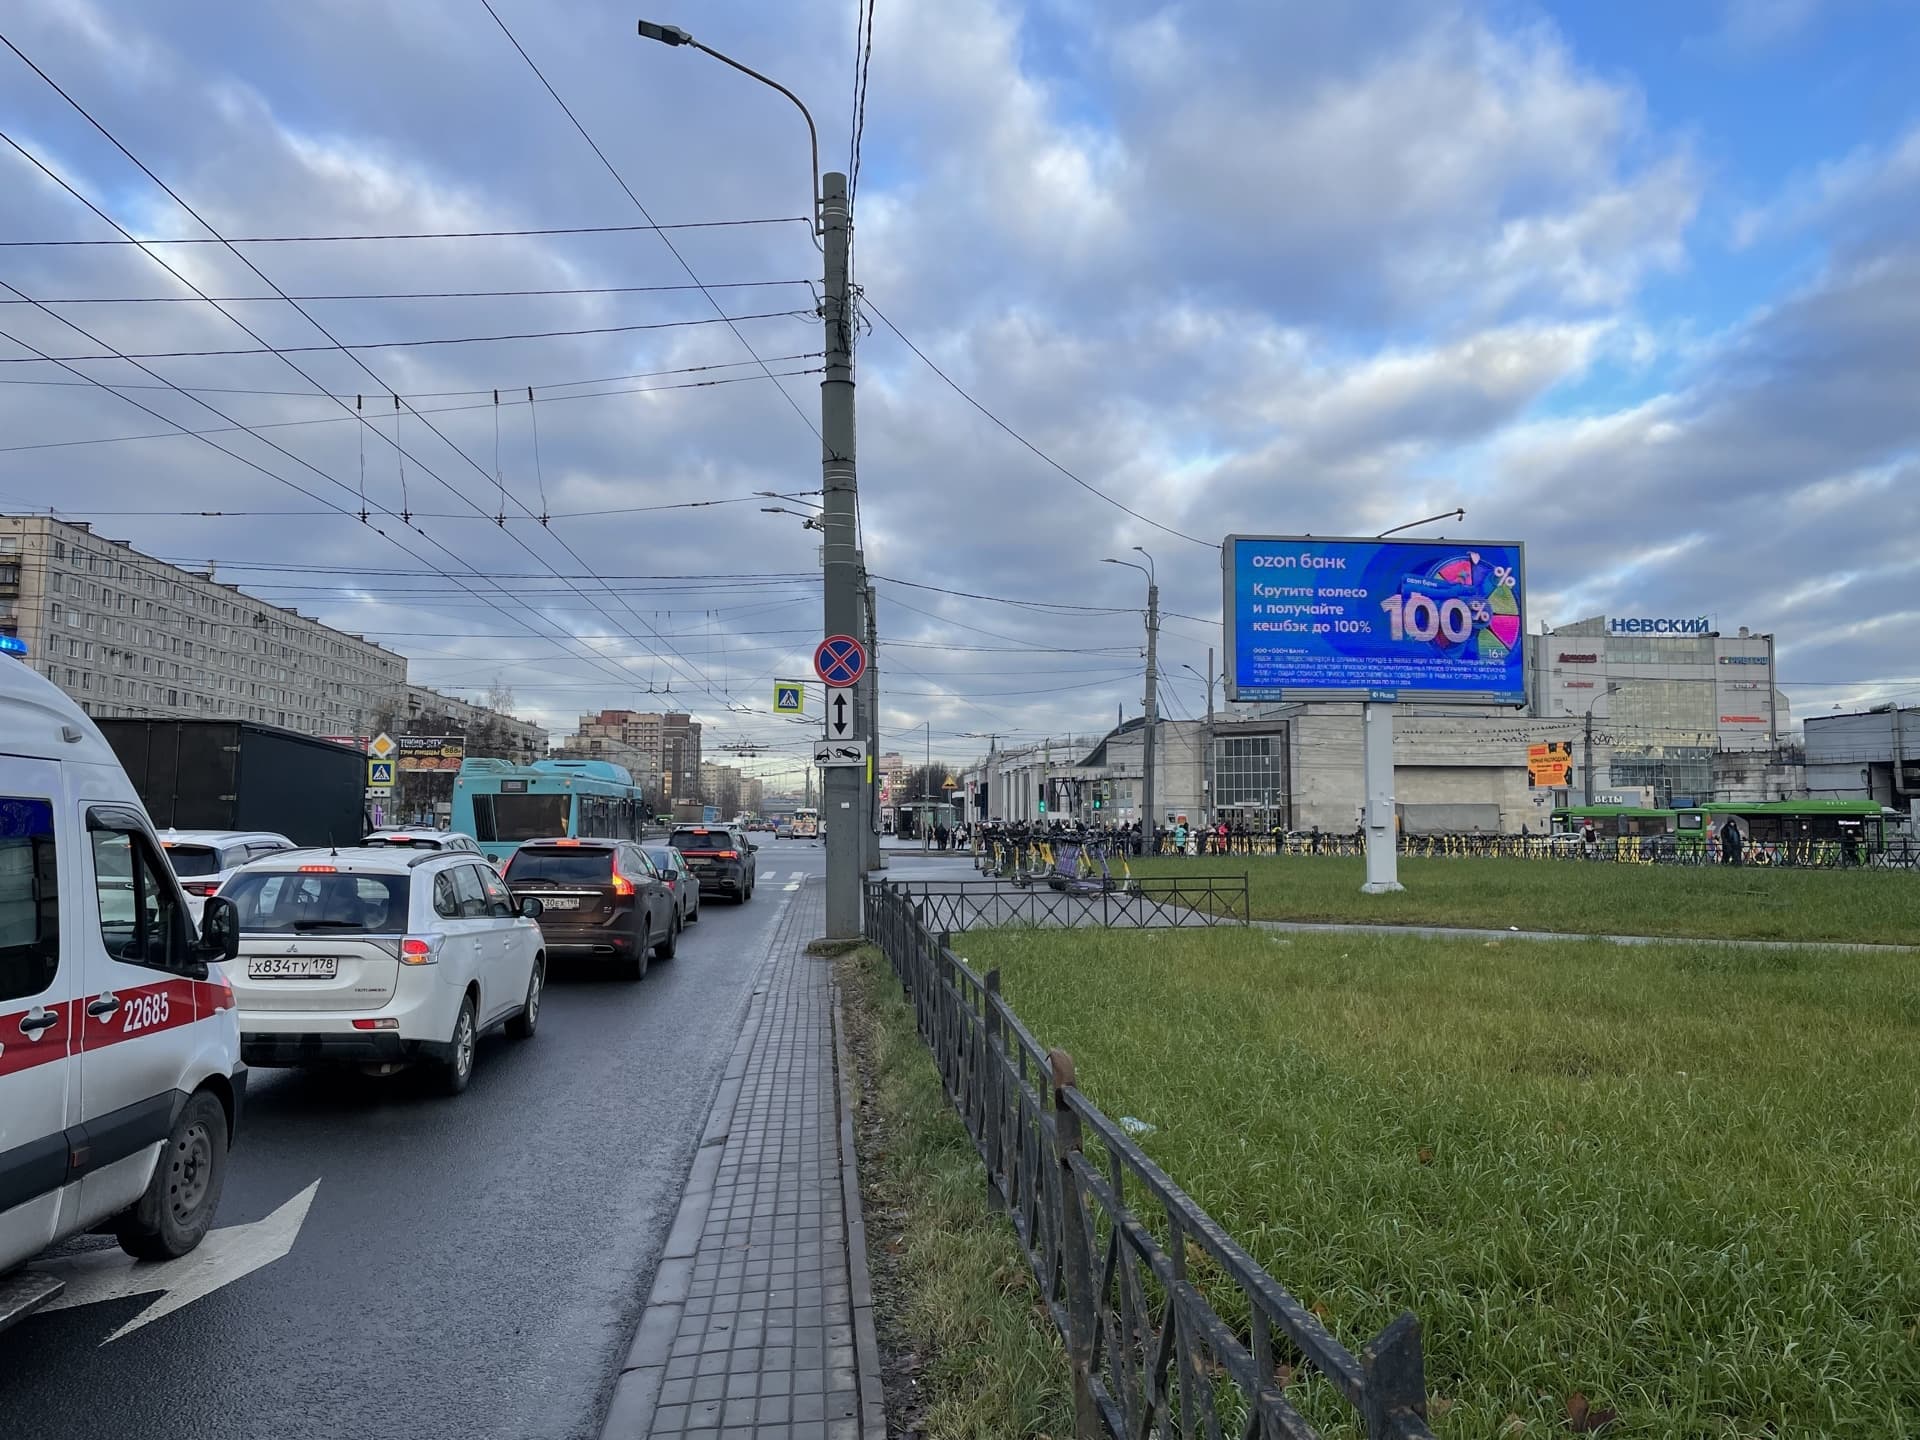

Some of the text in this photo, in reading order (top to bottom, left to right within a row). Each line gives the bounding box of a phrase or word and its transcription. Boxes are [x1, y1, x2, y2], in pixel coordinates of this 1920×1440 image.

[1252, 553, 1346, 569] ozon банк
[1253, 583, 1368, 598] Крутите колесо
[1253, 604, 1344, 616] и получайте
[1380, 592, 1490, 643] 100%
[1253, 620, 1371, 634] кешбэк до 100%
[1488, 649, 1504, 659] 16+
[254, 958, 333, 973] Х834ТУ 178
[123, 992, 169, 1032] 22685
